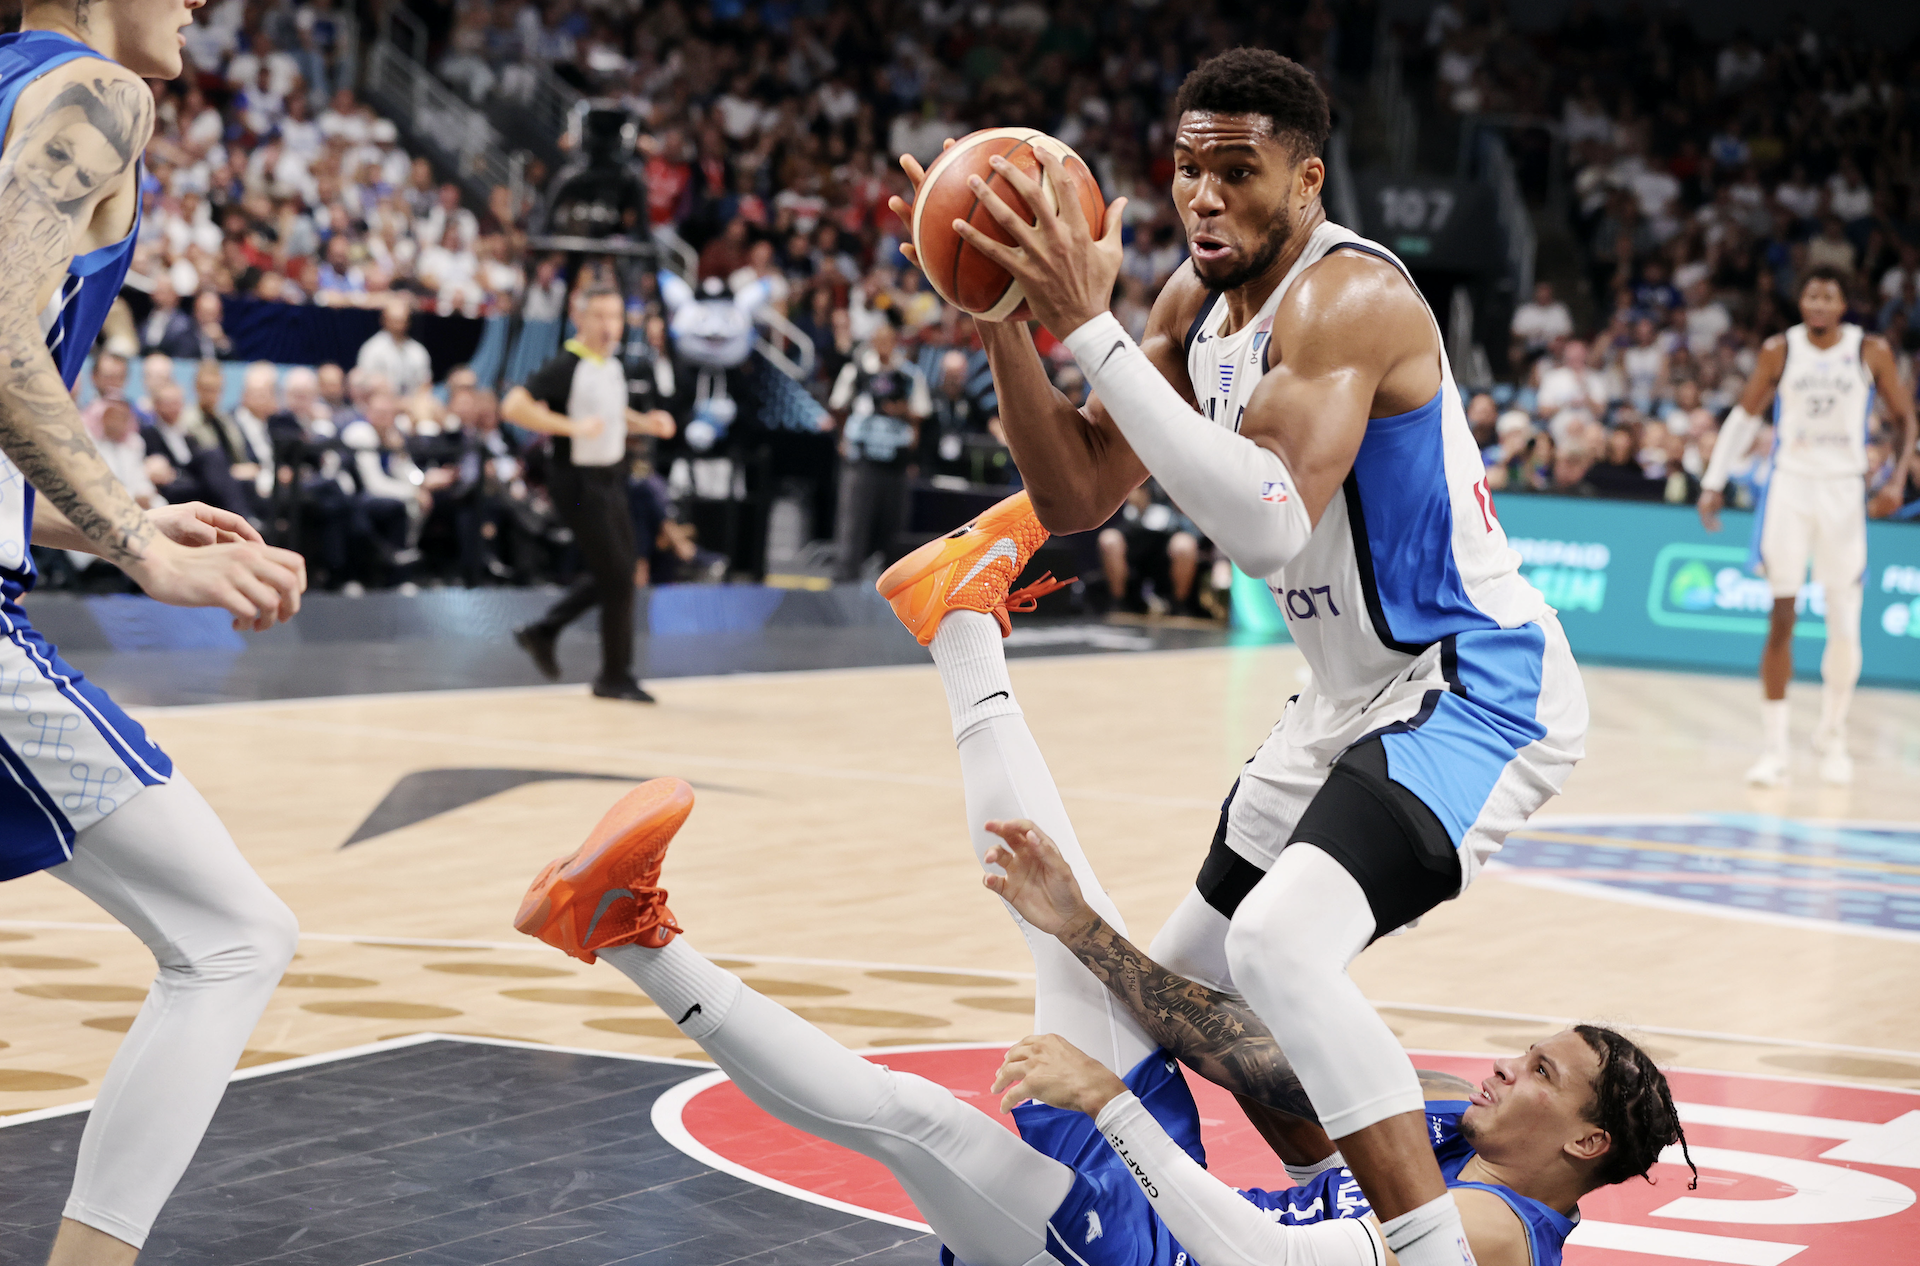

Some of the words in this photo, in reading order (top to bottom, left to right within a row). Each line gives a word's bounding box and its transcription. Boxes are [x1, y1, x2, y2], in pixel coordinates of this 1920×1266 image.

[1380, 187, 1455, 231] 107
[1522, 567, 1607, 613] SIM
[1119, 1149, 1159, 1199] CRAFT
